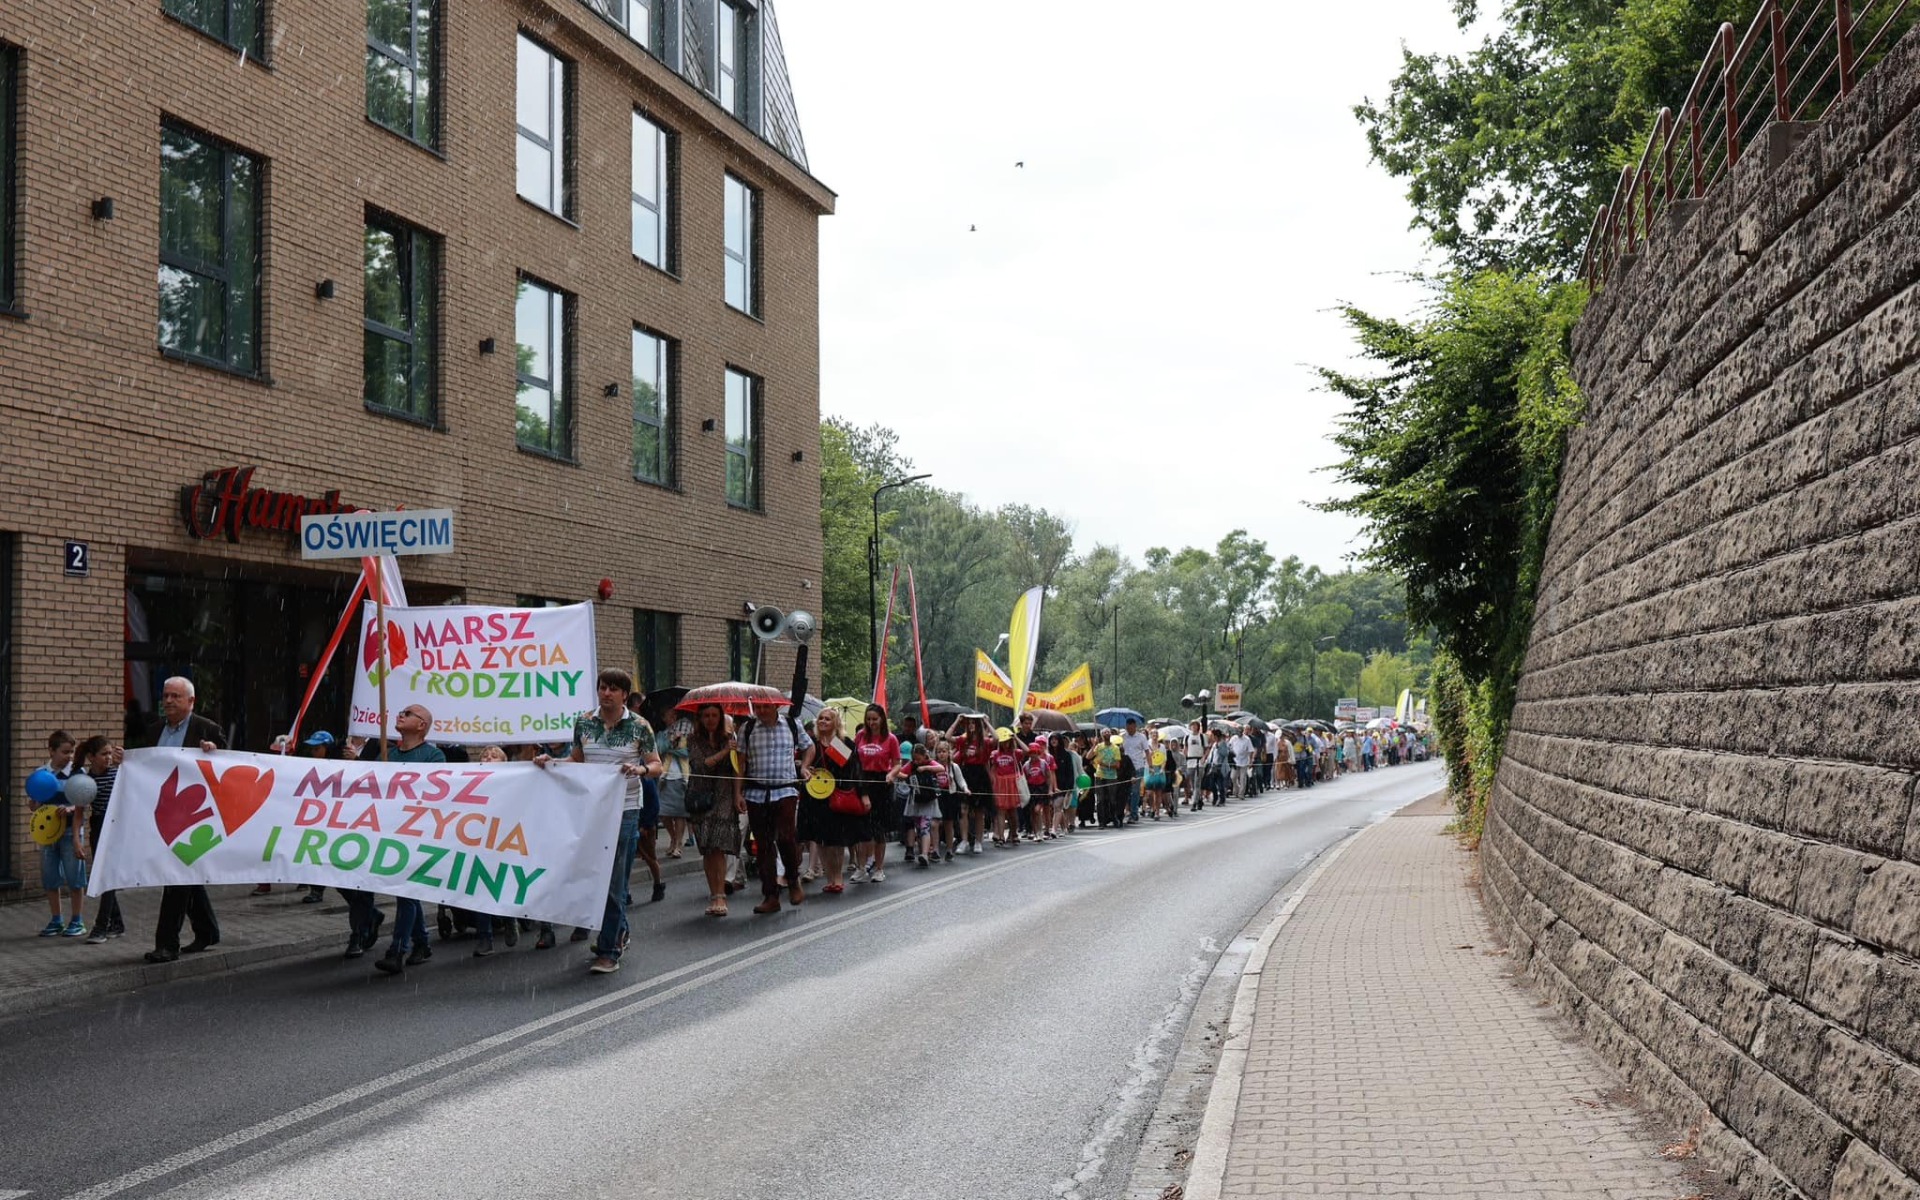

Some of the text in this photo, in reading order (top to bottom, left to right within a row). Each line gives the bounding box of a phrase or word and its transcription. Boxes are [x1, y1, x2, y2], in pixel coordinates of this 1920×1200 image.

[304, 516, 450, 554] OŚWIĘCIM
[72, 545, 83, 567] 2
[413, 612, 535, 649] MARSZ
[421, 642, 569, 671] DLA ŻYCIA
[426, 670, 584, 698] RODZINY
[433, 712, 514, 736] szłością
[292, 766, 496, 805] MARSZ
[294, 798, 529, 856] DLA ŻYCIA
[262, 826, 547, 905] I RODZINY
